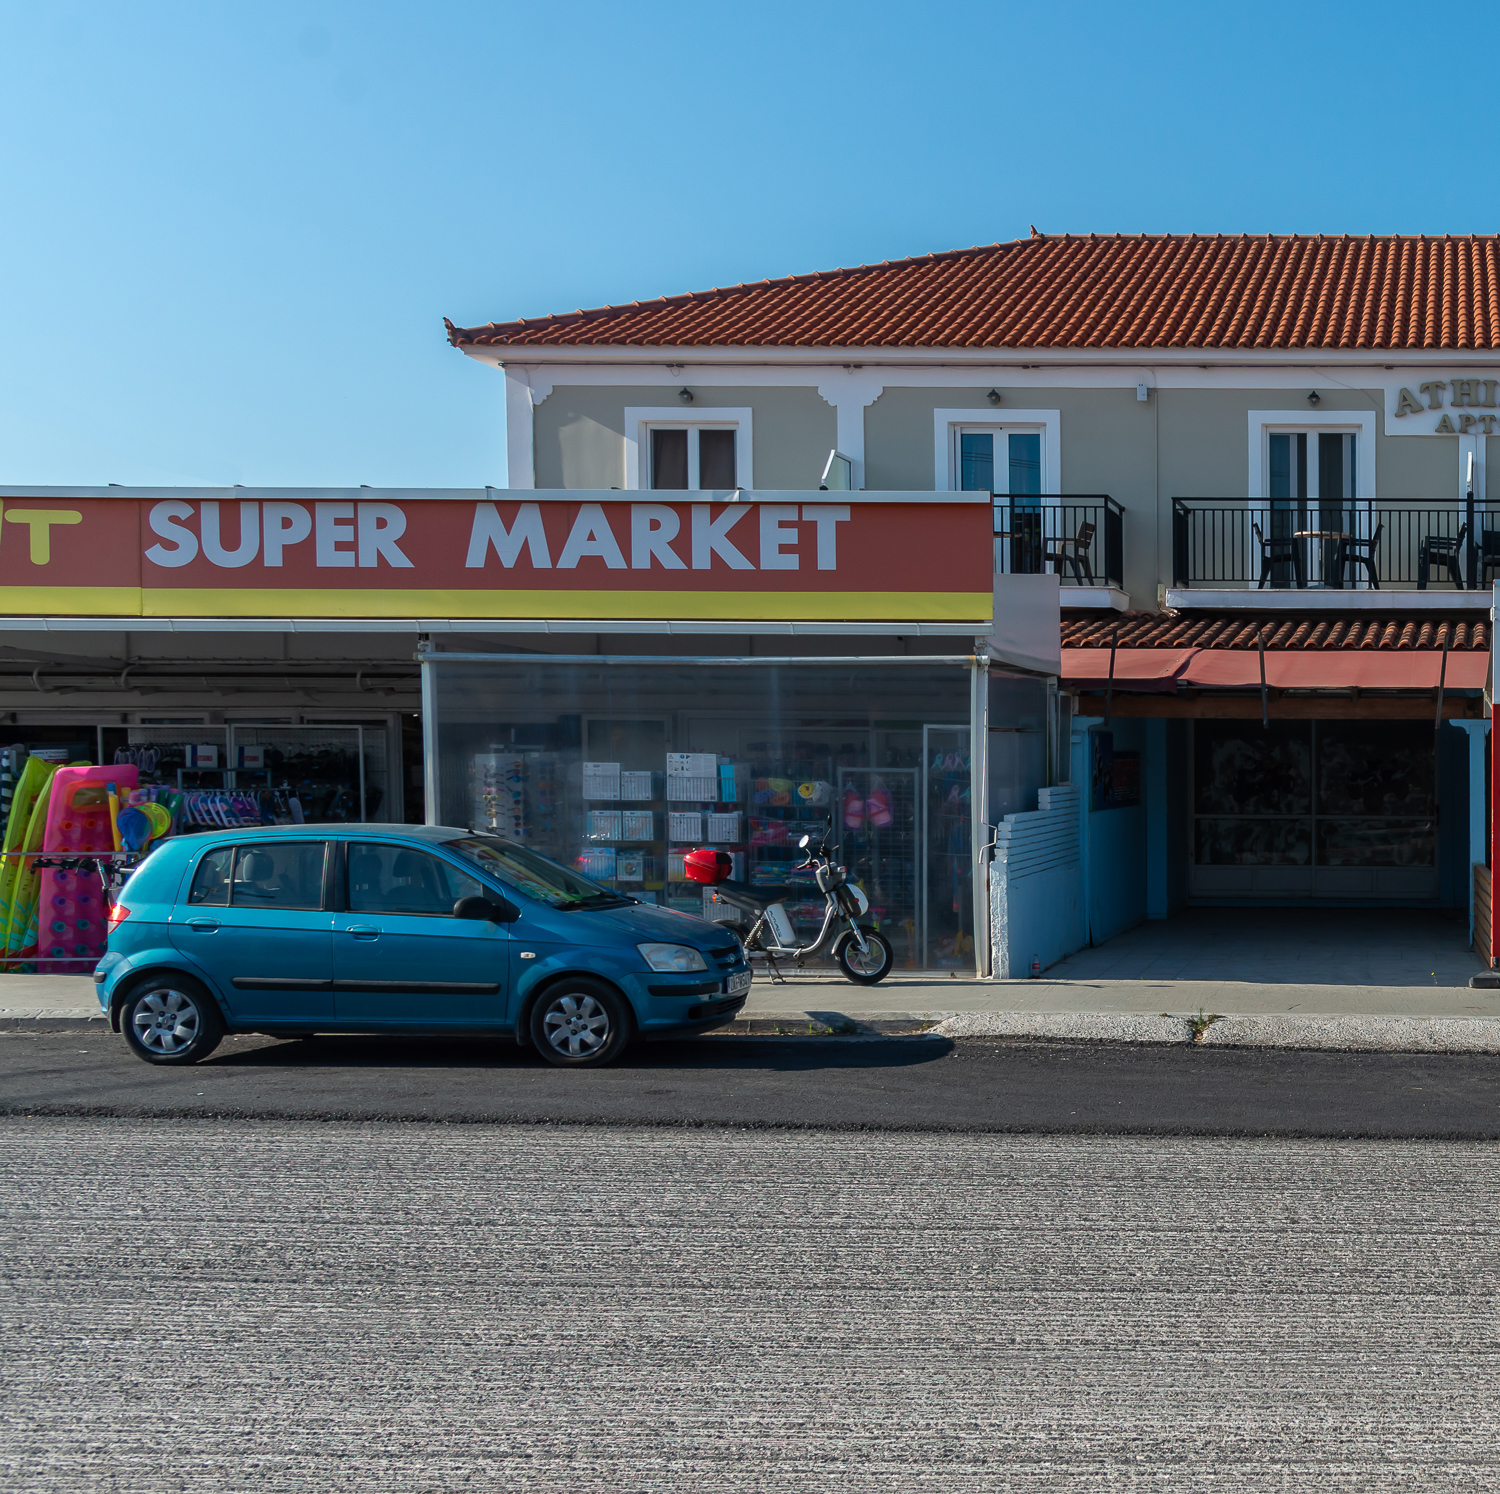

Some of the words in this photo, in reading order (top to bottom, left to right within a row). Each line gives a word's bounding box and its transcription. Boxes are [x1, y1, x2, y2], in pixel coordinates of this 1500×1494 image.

[0, 500, 83, 566] T
[144, 500, 415, 568] SUPER
[465, 502, 851, 571] MARKET
